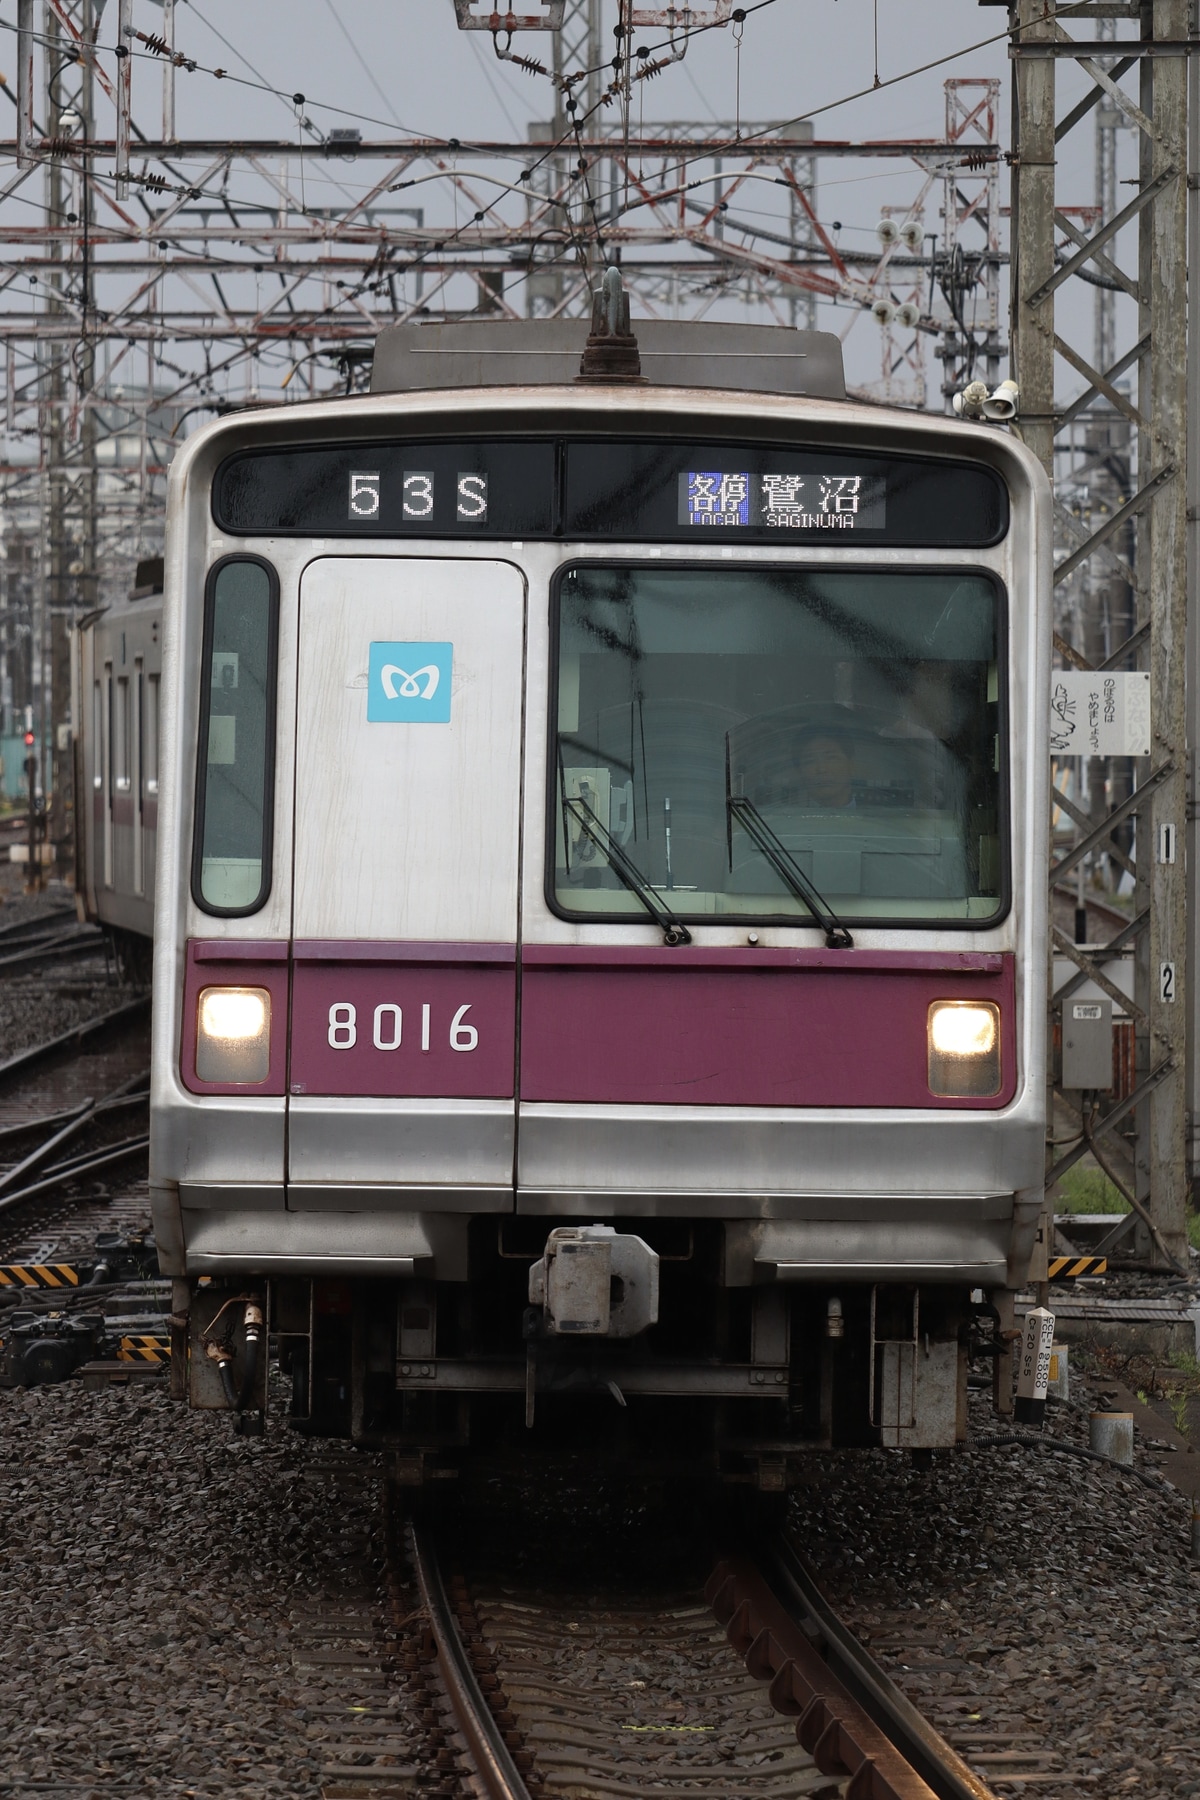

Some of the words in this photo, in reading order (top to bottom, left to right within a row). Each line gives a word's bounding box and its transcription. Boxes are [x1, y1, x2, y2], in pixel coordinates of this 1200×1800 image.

[689, 474, 748, 512] 各停
[766, 513, 854, 529] SAGINUMA
[1103, 678, 1116, 723] のぼるのは
[1164, 828, 1170, 858] 1
[1163, 966, 1173, 998] 2
[328, 1002, 478, 1052] 8016
